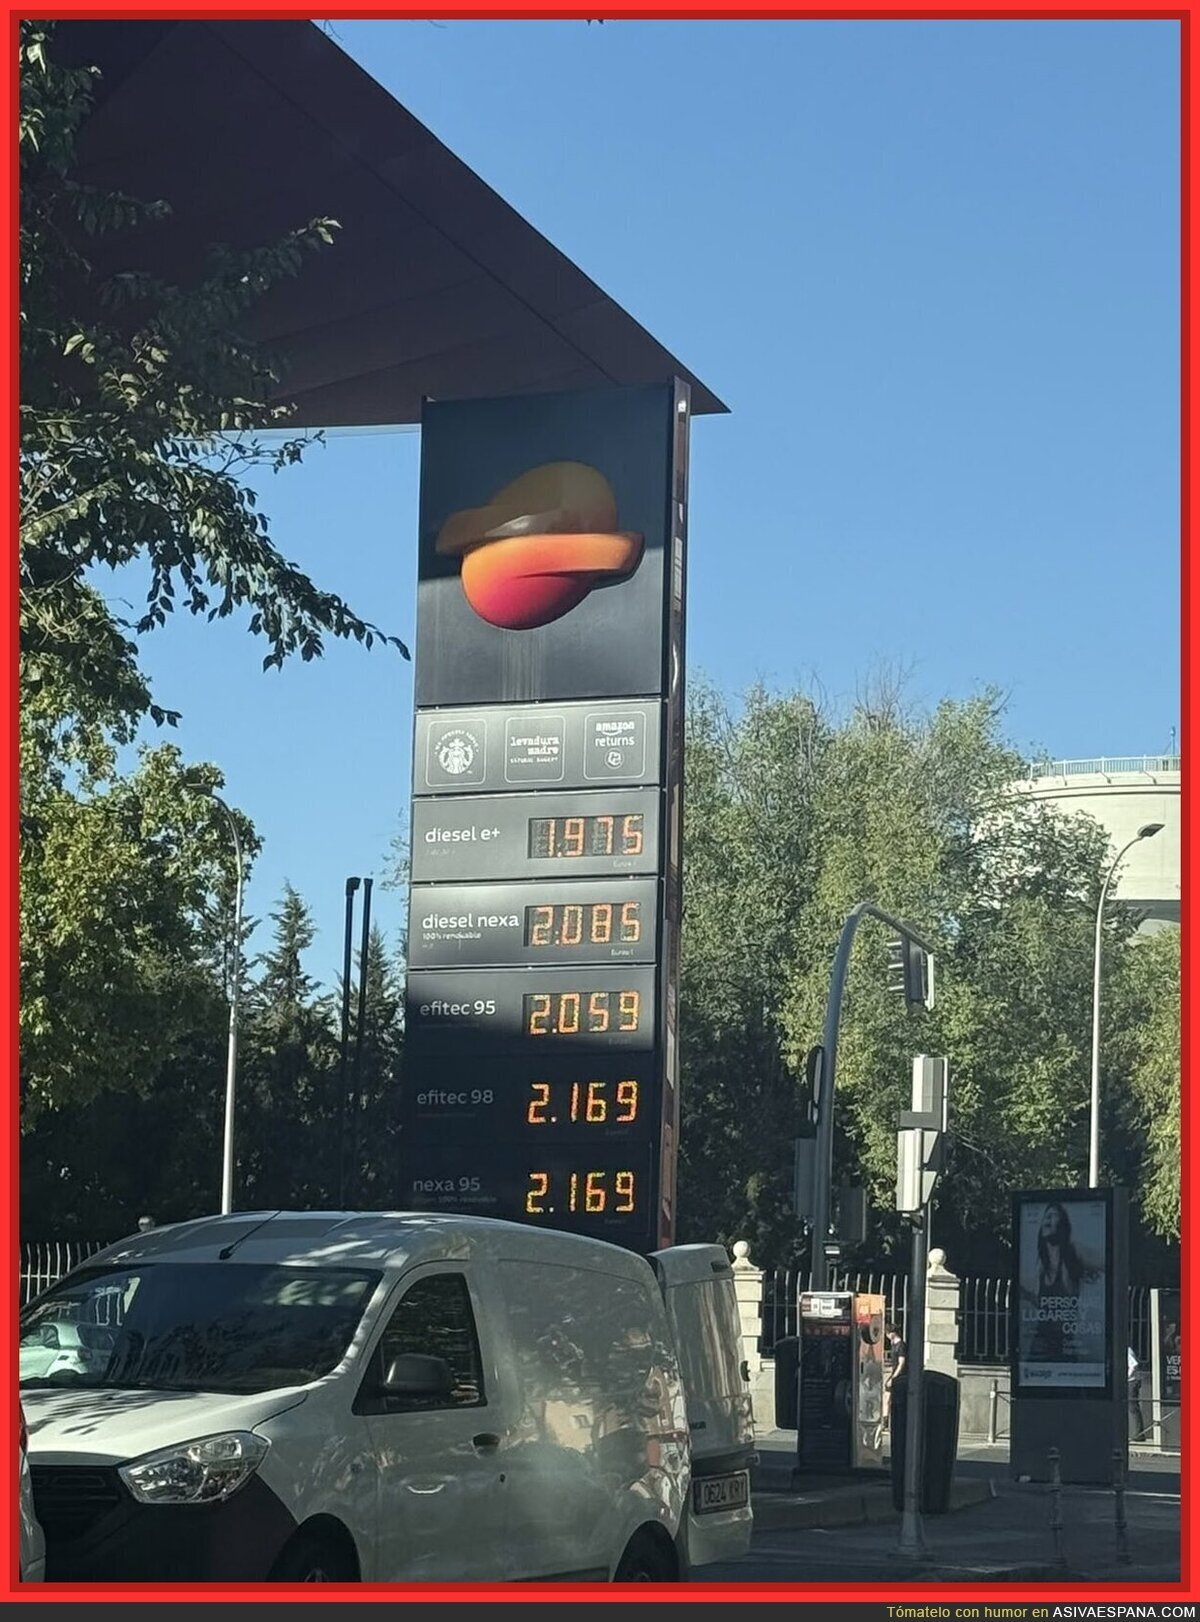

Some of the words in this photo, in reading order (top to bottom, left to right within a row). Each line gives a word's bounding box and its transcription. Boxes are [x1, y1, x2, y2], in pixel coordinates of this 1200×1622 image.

[595, 721, 635, 734] amazon
[595, 736, 635, 747] returns
[425, 826, 477, 843] diesel
[480, 827, 501, 841] e+
[546, 814, 643, 858] 1.975
[422, 912, 473, 929] diesel
[477, 914, 520, 928] nexa
[531, 901, 641, 946] 2.085
[419, 1000, 471, 1016] efitec
[473, 1000, 496, 1015] 95
[529, 991, 640, 1036] 2.059
[416, 1089, 468, 1105] efitec
[470, 1089, 494, 1104] 98
[527, 1080, 639, 1124] 2.169
[413, 1178, 455, 1192] nexa
[458, 1177, 481, 1192] 95
[525, 1171, 635, 1213] 2.169
[1022, 1309, 1077, 1321] LUGARES
